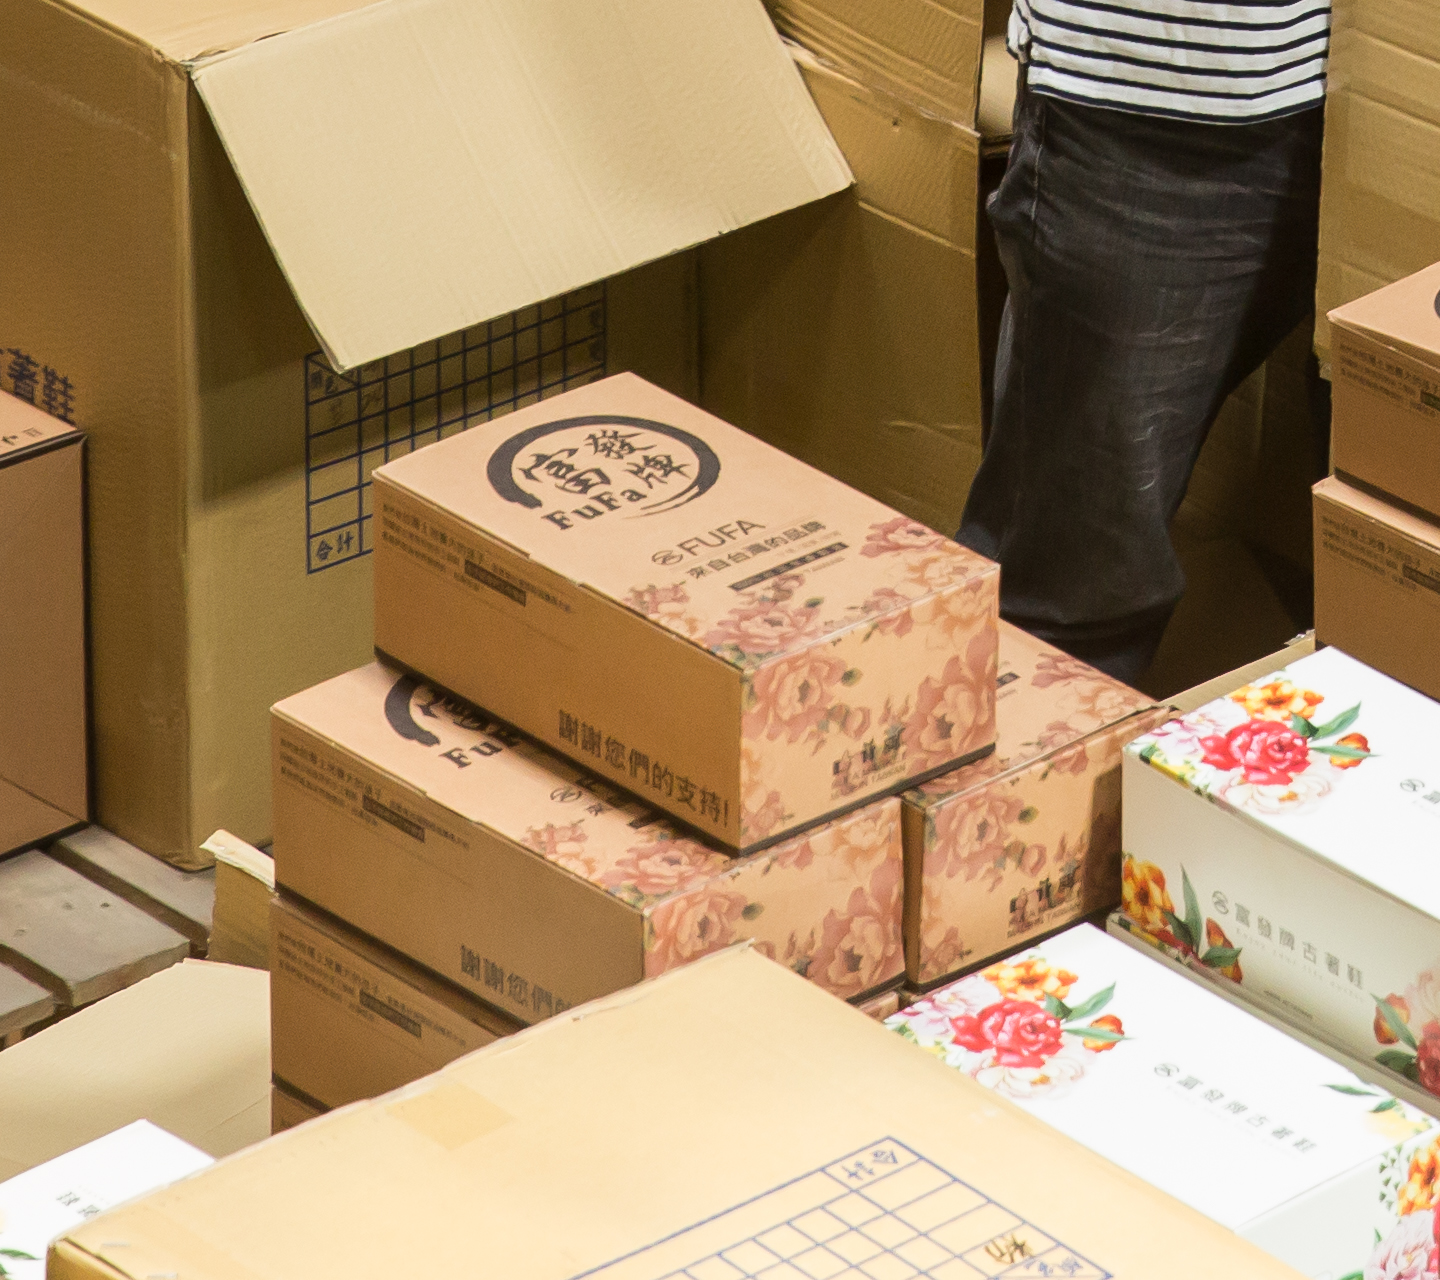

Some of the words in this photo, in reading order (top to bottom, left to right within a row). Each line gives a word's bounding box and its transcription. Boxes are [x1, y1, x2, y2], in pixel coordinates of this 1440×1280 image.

[521, 430, 695, 496] 富發牌
[544, 488, 649, 532] FuFa
[677, 519, 768, 557] FUFA
[1234, 902, 1364, 990] 富發牌古著鞋
